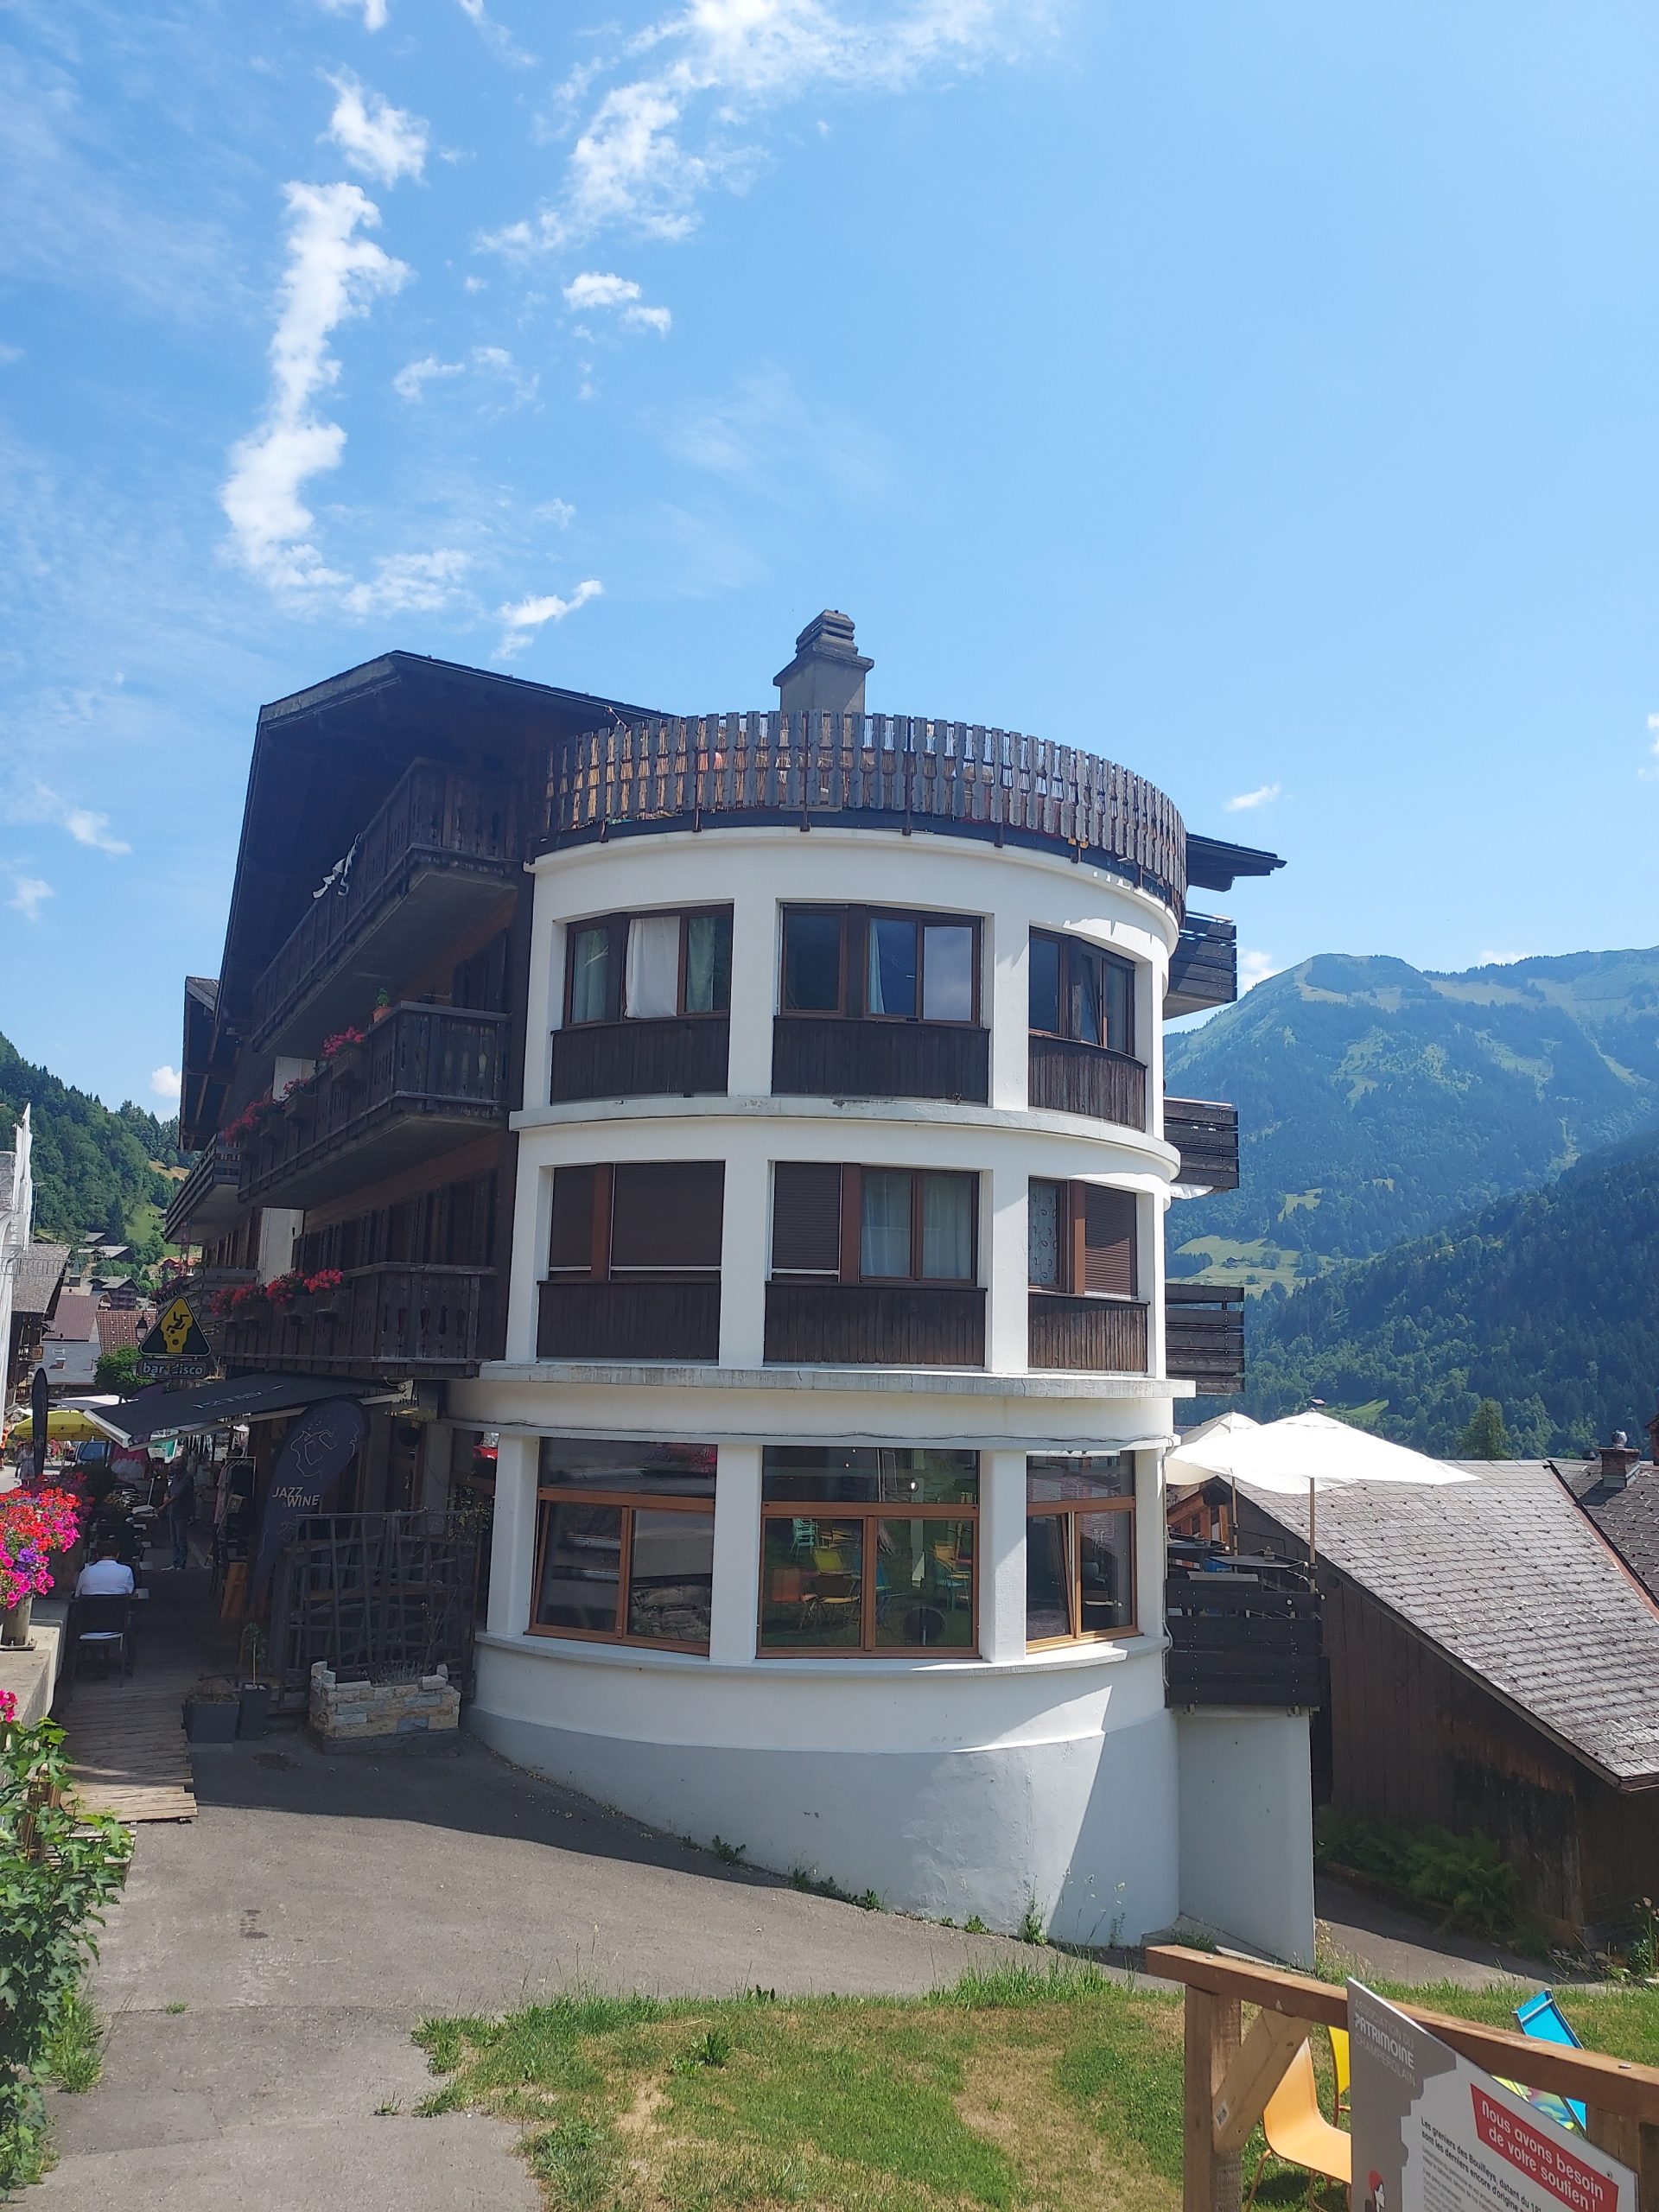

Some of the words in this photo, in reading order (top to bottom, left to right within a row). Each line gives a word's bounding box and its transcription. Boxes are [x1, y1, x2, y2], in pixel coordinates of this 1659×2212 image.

[143, 1363, 164, 1375] bar
[172, 1363, 203, 1375] disco
[272, 1487, 303, 1497] JAZZ
[287, 1495, 320, 1507] WINE
[1354, 2012, 1415, 2070] PATRIMOINE
[1421, 2116, 1431, 2132] Les
[1433, 2127, 1456, 2151] greniers
[1457, 2145, 1468, 2160] des
[1499, 2179, 1520, 2202] datant
[1521, 2196, 1529, 2209] du
[1422, 2131, 1434, 2145] sont
[1435, 2139, 1444, 2153] les
[1445, 2148, 1469, 2173] derniers
[1470, 2169, 1491, 2190] encore
[1482, 2100, 1511, 2133] Nous
[1515, 2127, 1553, 2164] avons
[1556, 2153, 1604, 2201] besoin
[1489, 2126, 1504, 2147] de
[1508, 2141, 1537, 2171] votre
[1541, 2166, 1589, 2212] soutien
